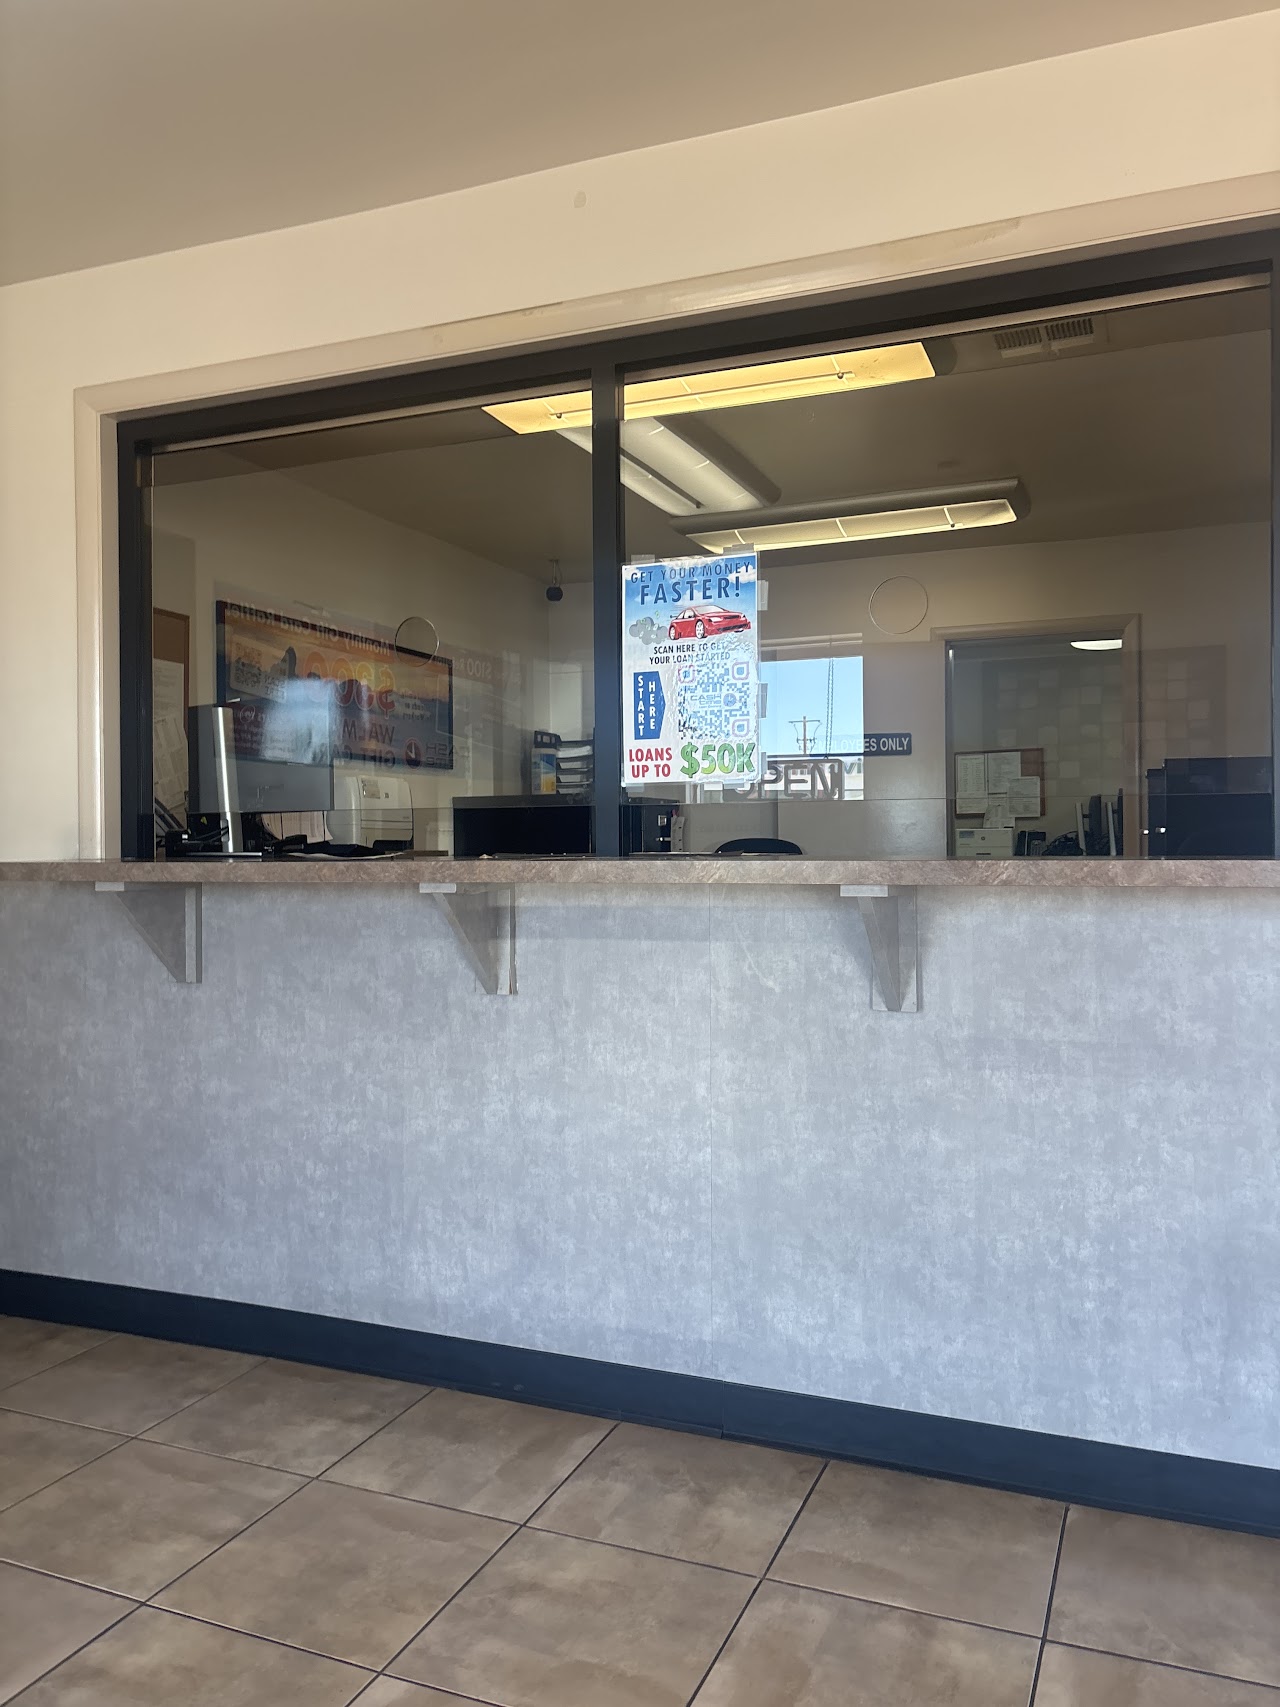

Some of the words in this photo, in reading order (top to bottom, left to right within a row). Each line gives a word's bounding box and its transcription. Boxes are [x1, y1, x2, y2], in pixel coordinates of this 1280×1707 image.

[631, 570, 653, 584] GET
[661, 566, 695, 580] YOUR
[702, 561, 750, 577] MONEY
[640, 576, 740, 605] FASTER!
[653, 645, 674, 655] SCAN
[676, 643, 695, 653] HERE
[698, 642, 708, 651] TO
[710, 641, 726, 651] GET
[649, 655, 670, 665] YOUR
[672, 654, 694, 664] LOAN
[695, 652, 731, 662] STARTED
[637, 675, 645, 737] START
[648, 681, 656, 730] HERE
[880, 737, 909, 750] ONLY
[629, 747, 672, 762] LOANS
[680, 742, 756, 778] $50K
[631, 764, 649, 778] UP
[654, 763, 671, 777] TO
